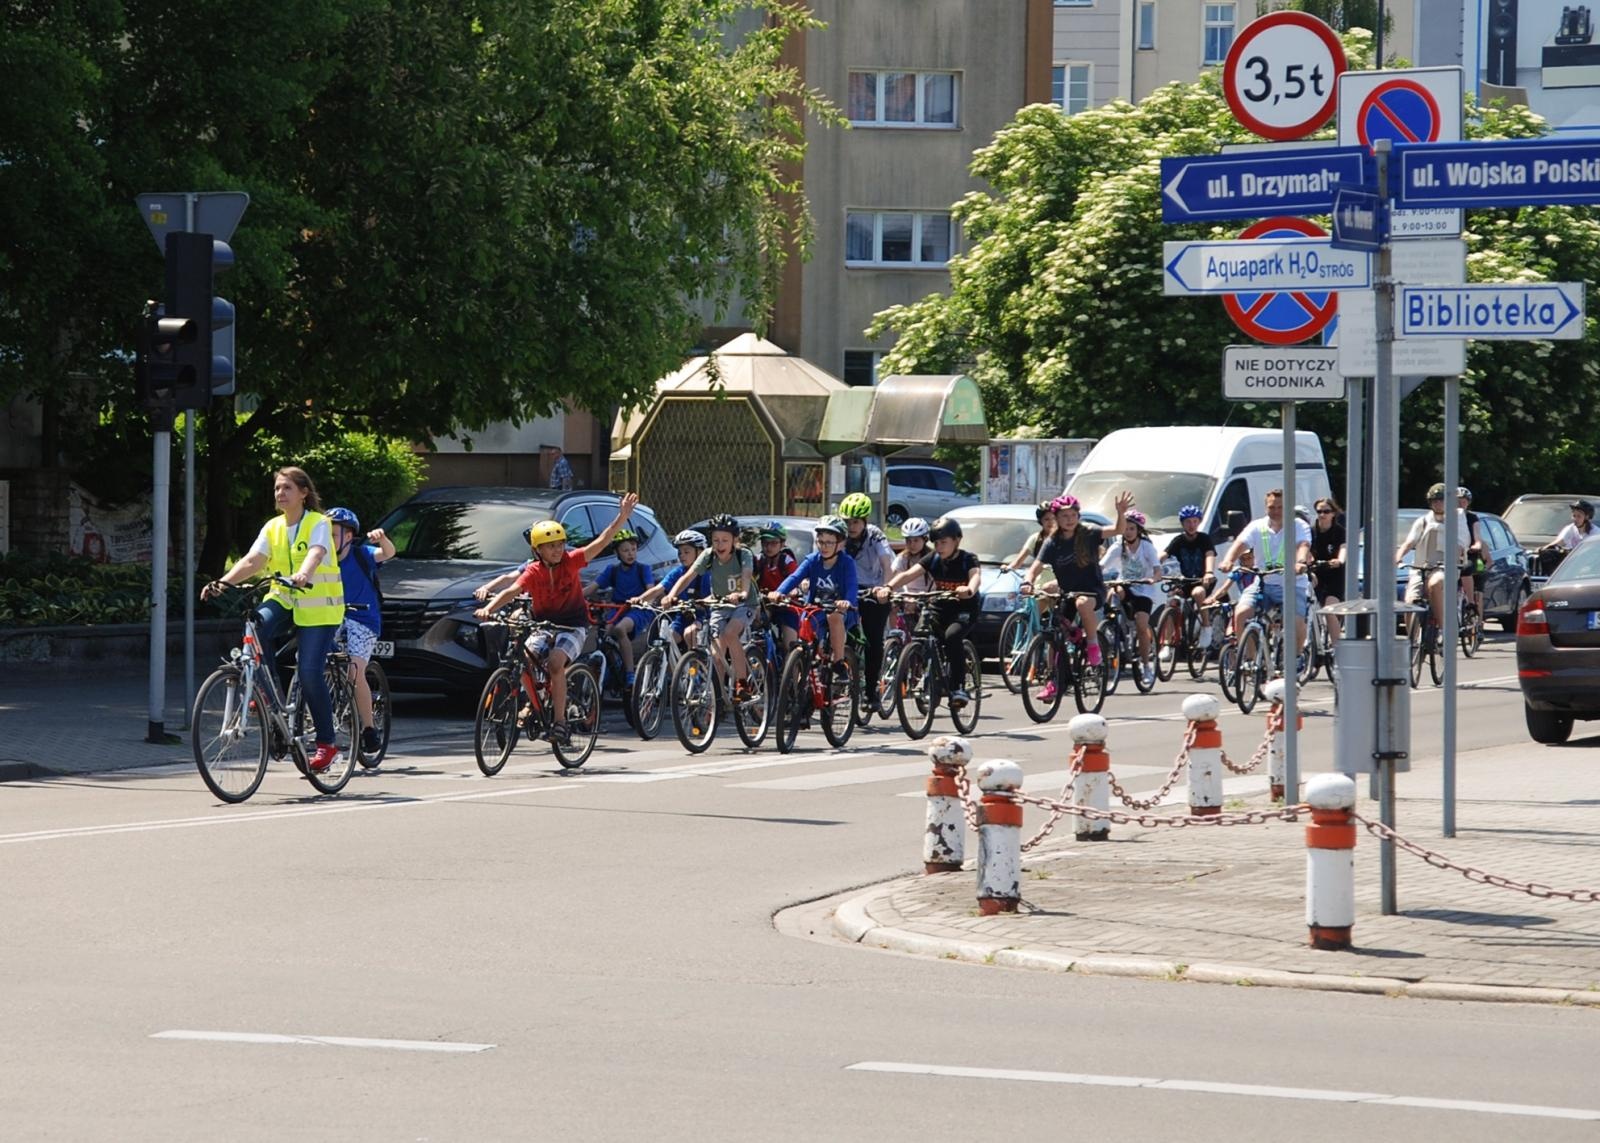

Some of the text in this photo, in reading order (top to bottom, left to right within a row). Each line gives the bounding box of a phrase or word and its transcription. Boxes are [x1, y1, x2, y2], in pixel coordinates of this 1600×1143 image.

[1208, 175, 1235, 198] ul.
[1413, 163, 1440, 187] ul.
[1447, 160, 1527, 188] Wojska
[1207, 255, 1284, 282] Aquapark
[1409, 293, 1555, 327] Biblioteka
[1235, 359, 1336, 371] NIE DOTYCZY
[1245, 375, 1325, 388] CHODNIKA
